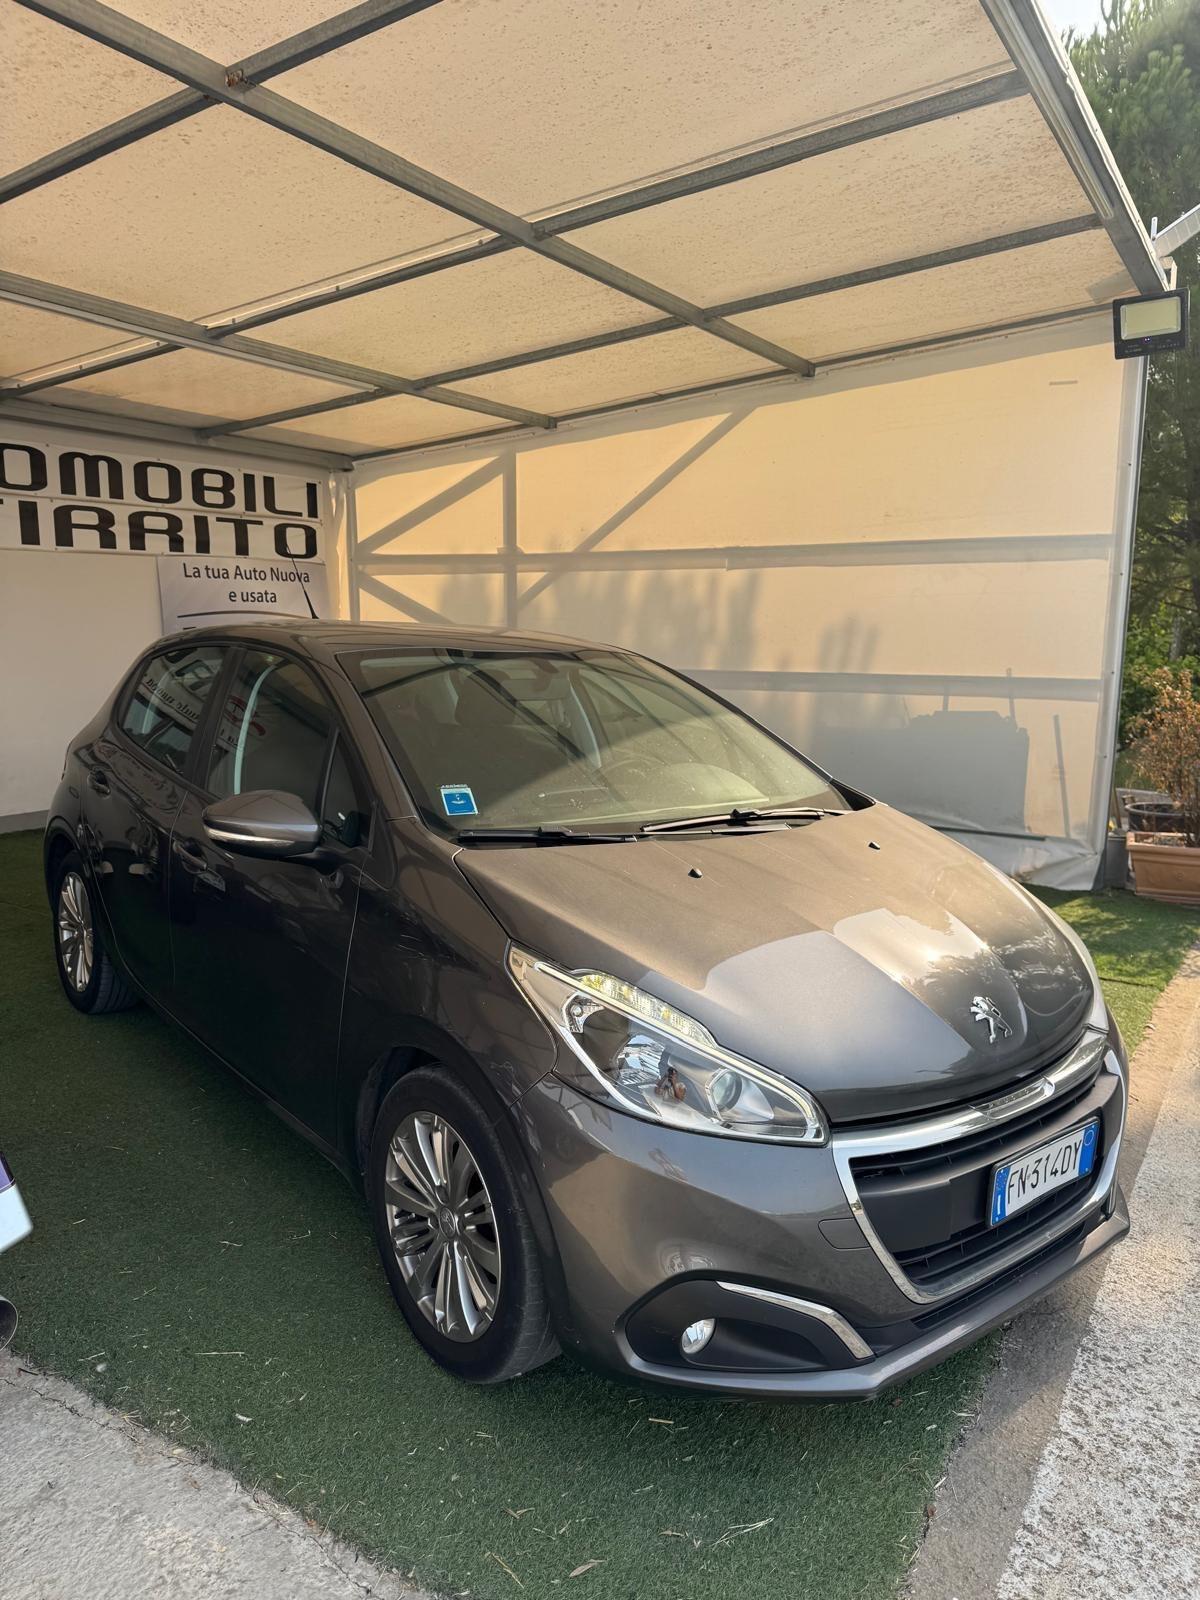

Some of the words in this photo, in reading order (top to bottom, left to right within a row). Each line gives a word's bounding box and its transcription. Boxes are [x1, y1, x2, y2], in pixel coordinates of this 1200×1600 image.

[0, 498, 318, 559] IRRITO
[183, 562, 201, 578] La
[205, 565, 230, 579] tua
[234, 565, 267, 581] Auto
[271, 567, 310, 583] Nuova
[229, 590, 237, 602] e
[241, 589, 277, 603] usata
